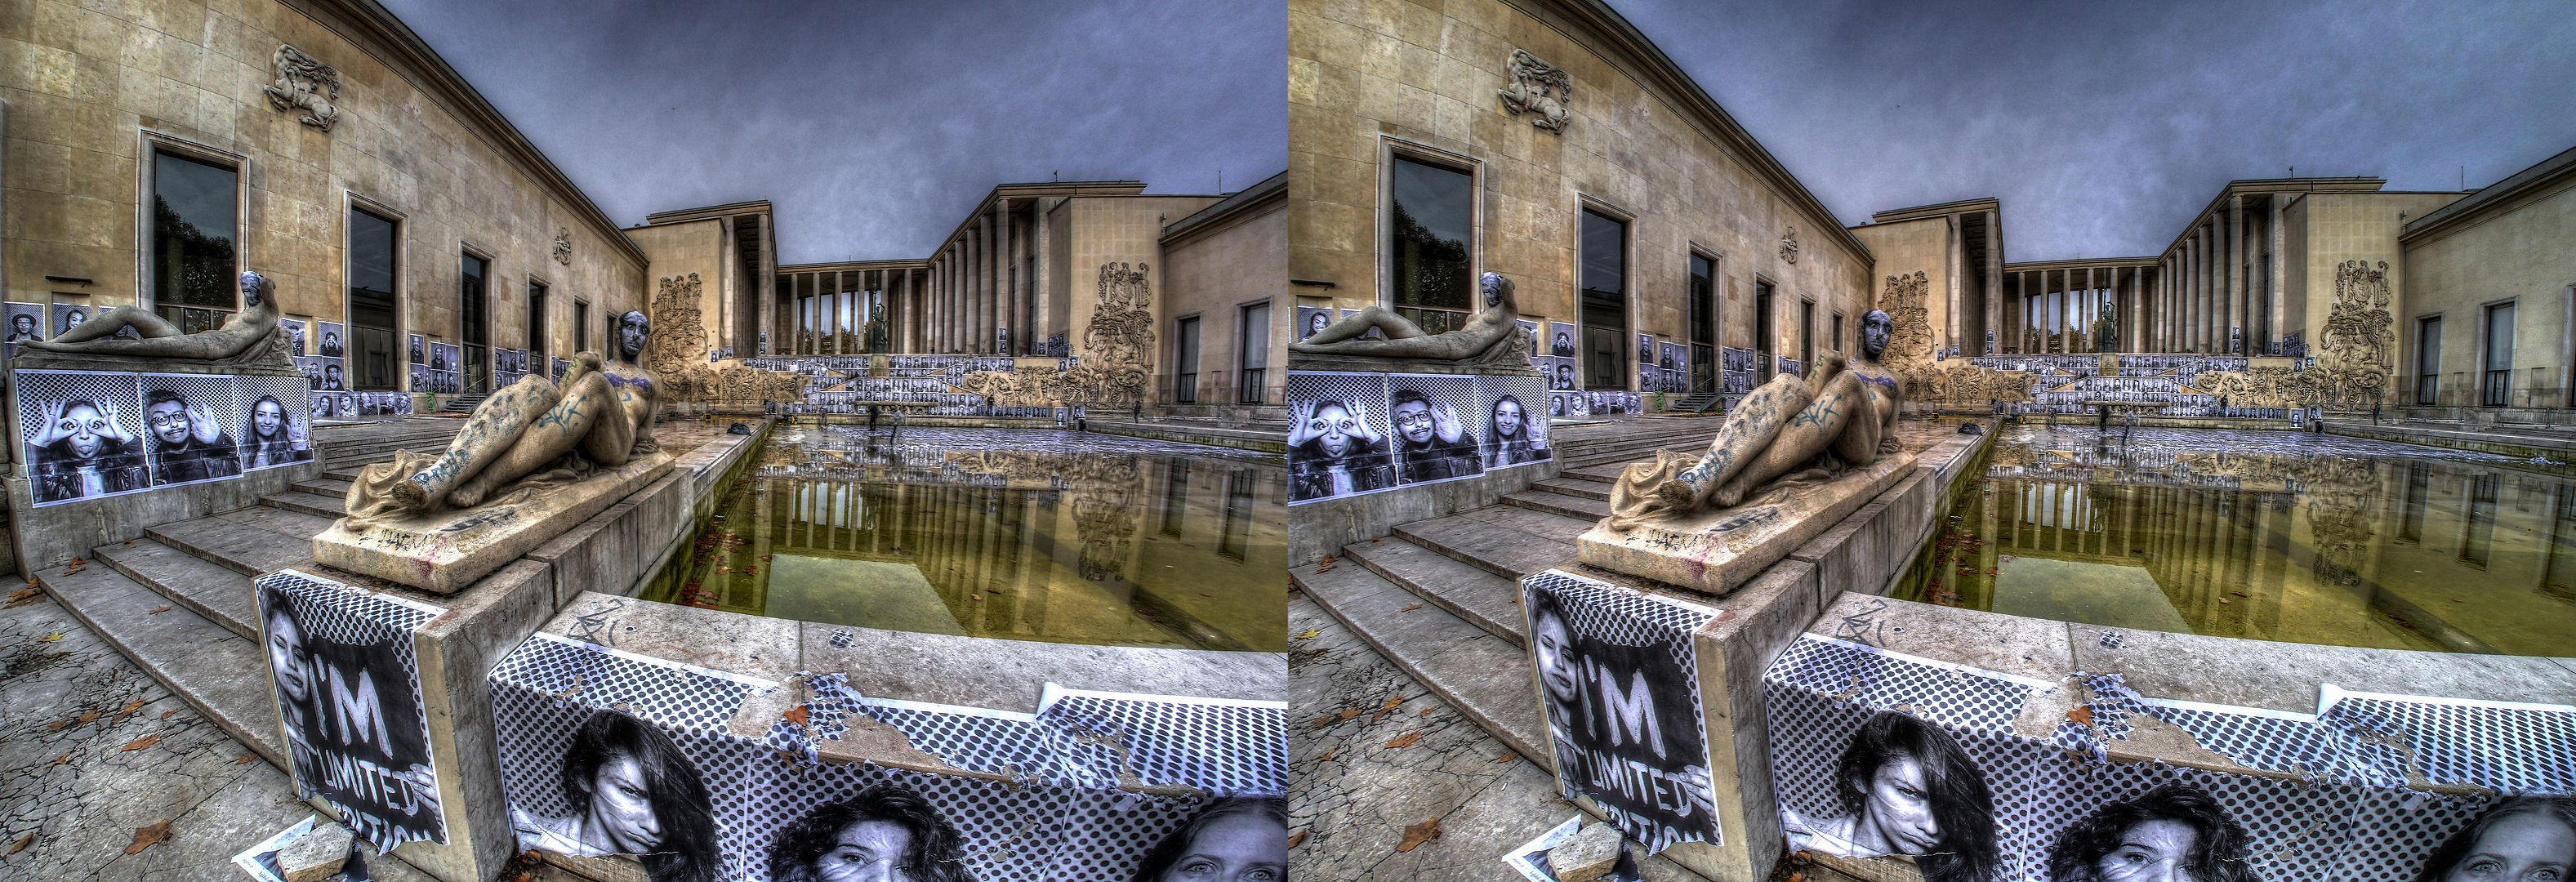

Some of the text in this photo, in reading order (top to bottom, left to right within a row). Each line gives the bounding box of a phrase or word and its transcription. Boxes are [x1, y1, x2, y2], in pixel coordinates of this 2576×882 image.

[308, 653, 394, 760] I'M
[1577, 653, 1667, 760] I'M
[316, 745, 419, 817] LIMITED
[1584, 746, 1693, 817] LIMITED
